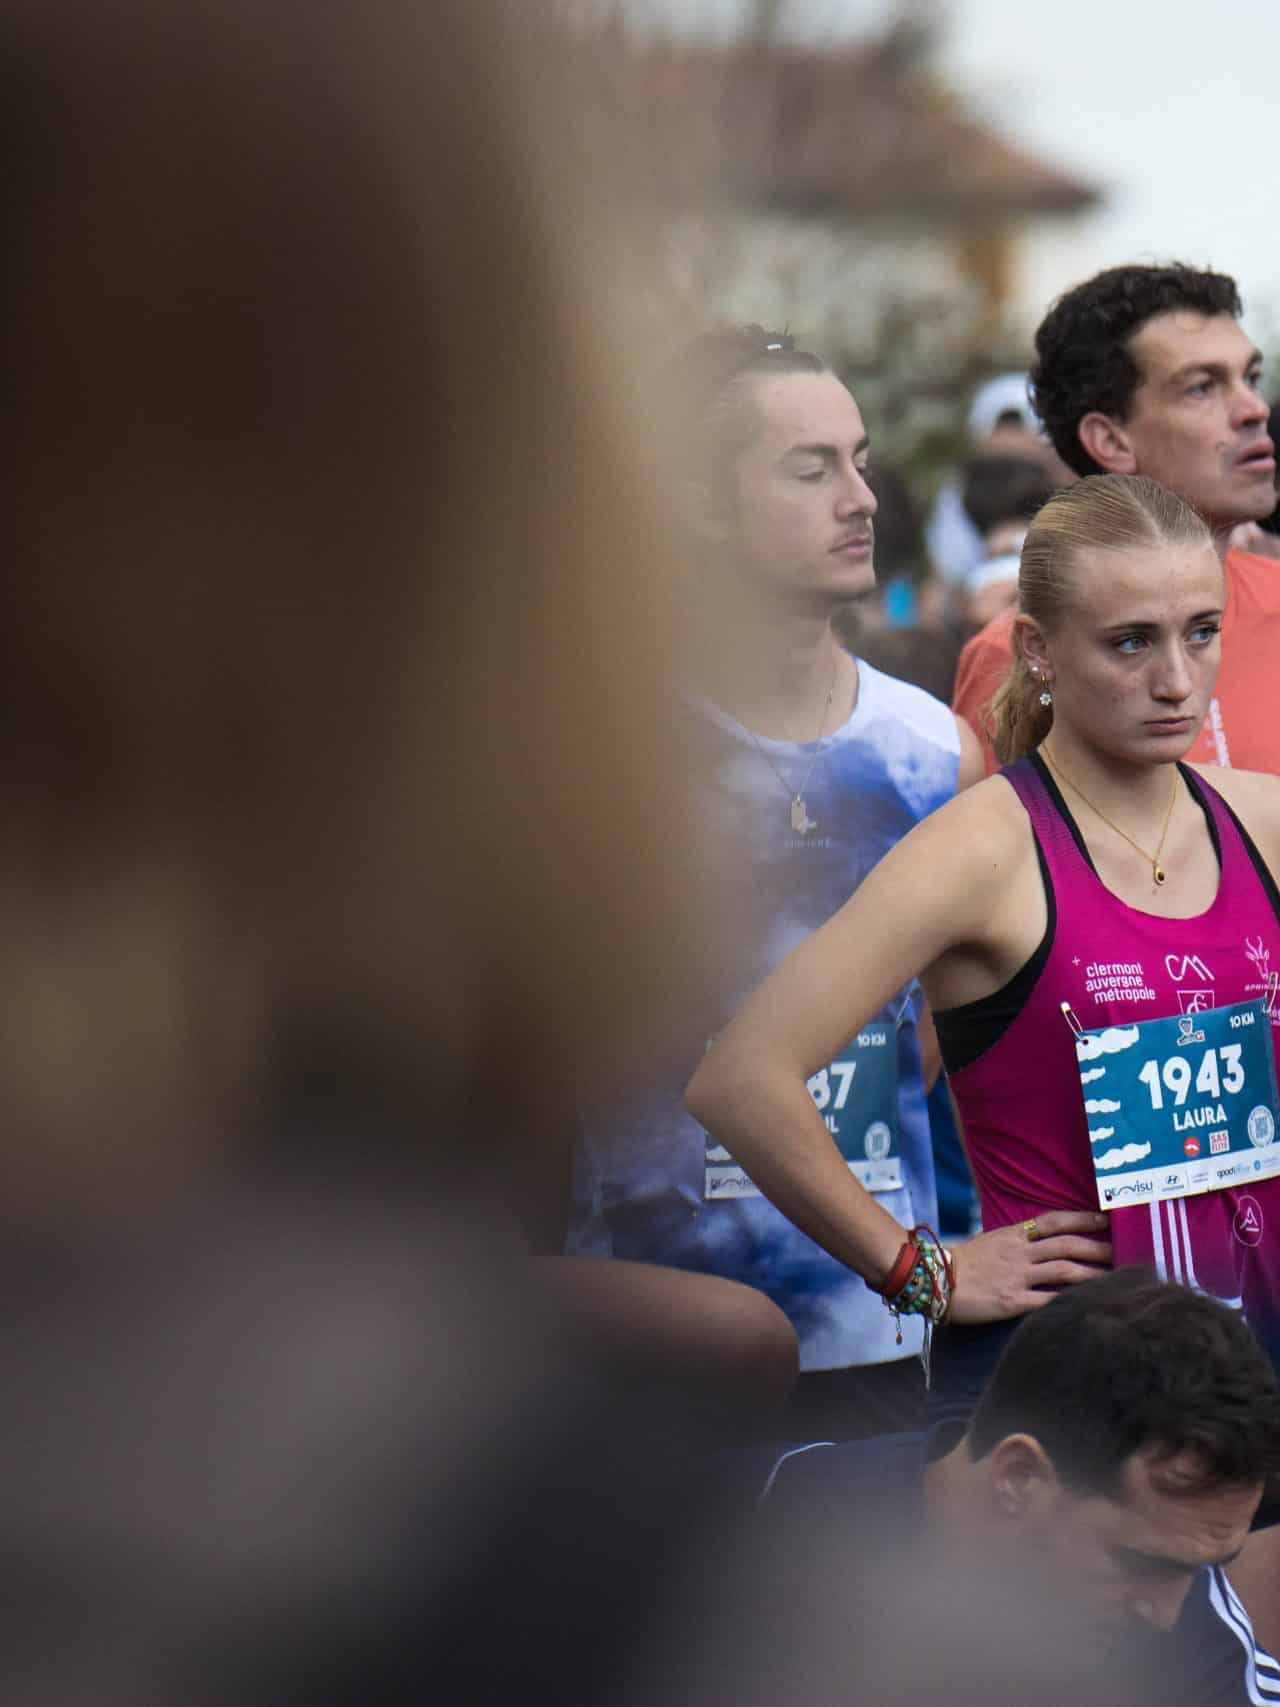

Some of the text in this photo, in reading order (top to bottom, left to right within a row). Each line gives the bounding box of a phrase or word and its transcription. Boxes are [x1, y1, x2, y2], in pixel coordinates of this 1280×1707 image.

[1086, 962, 1144, 978] clermont
[1085, 975, 1144, 993] auvergne
[1229, 1015, 1241, 1029] 10
[1241, 1011, 1256, 1027] KM
[856, 1032, 887, 1047] 10 KM
[1138, 1043, 1245, 1110] 1943
[1173, 1103, 1228, 1131] LAURA
